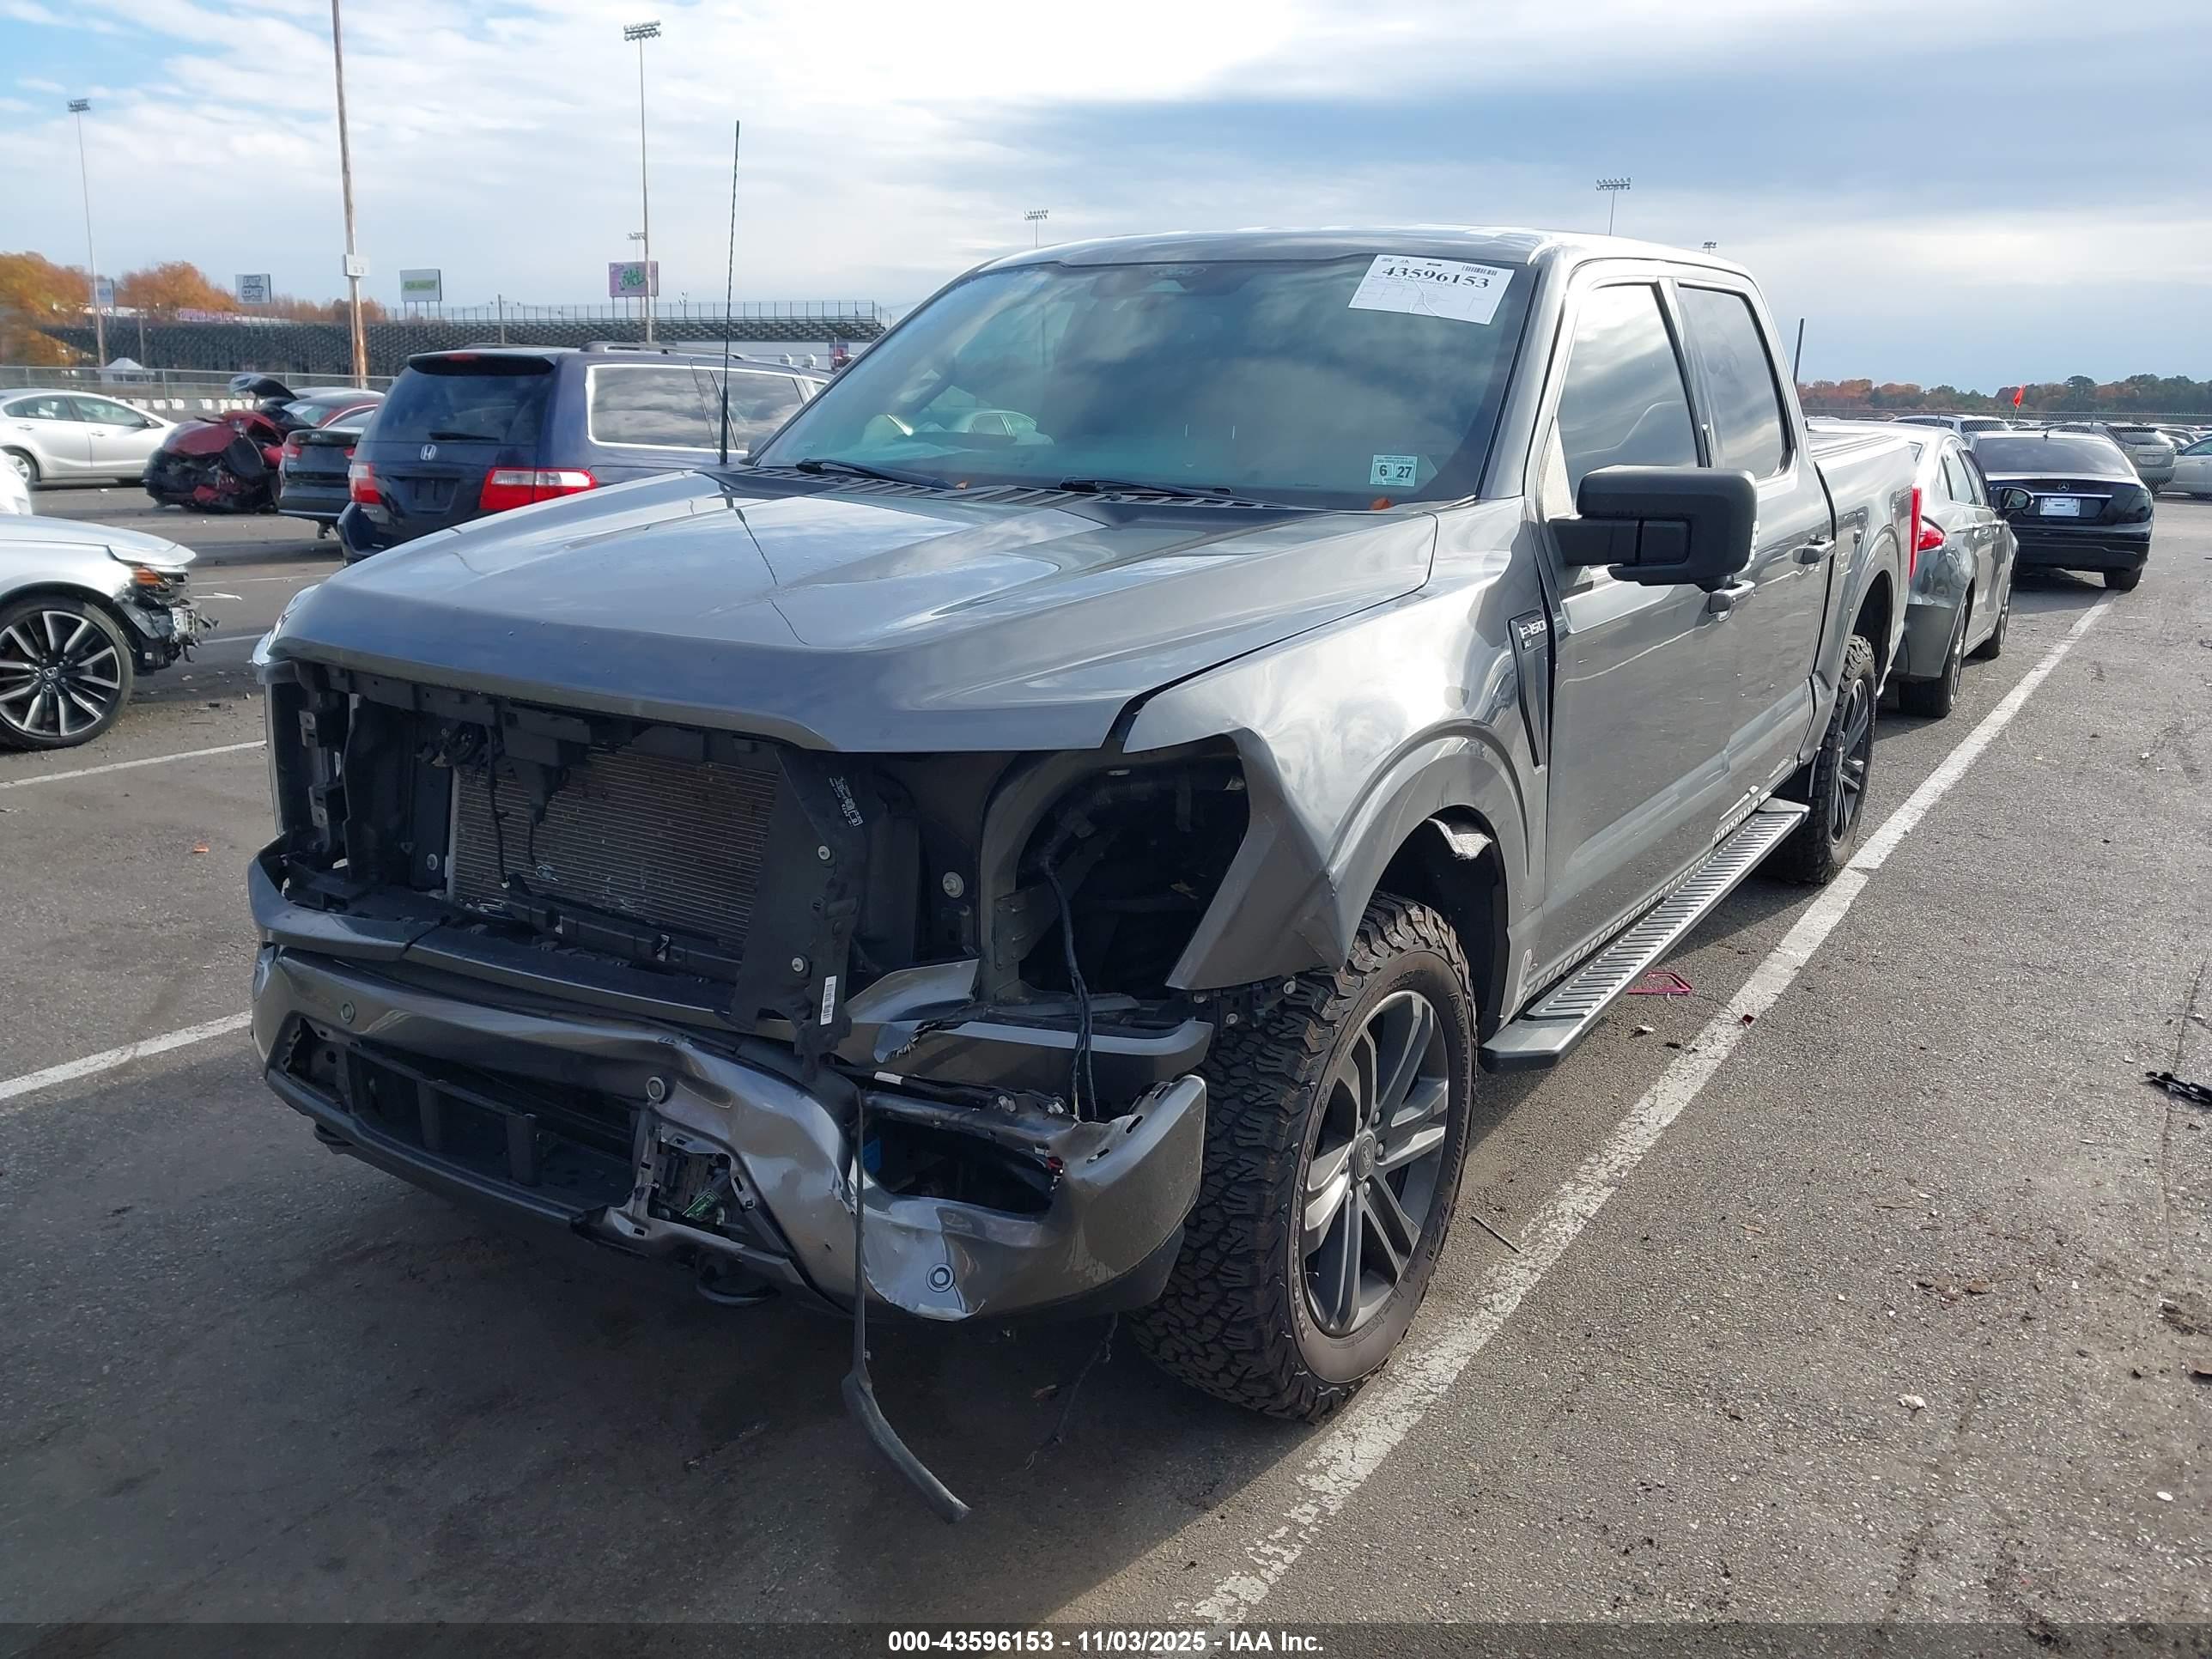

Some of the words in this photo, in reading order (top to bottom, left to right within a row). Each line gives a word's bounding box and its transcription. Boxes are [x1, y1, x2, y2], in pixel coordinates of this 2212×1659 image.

[1382, 265, 1491, 289] 43596153
[1379, 465, 1388, 477] 6
[1396, 465, 1413, 478] 27
[1518, 619, 1547, 639] F-150
